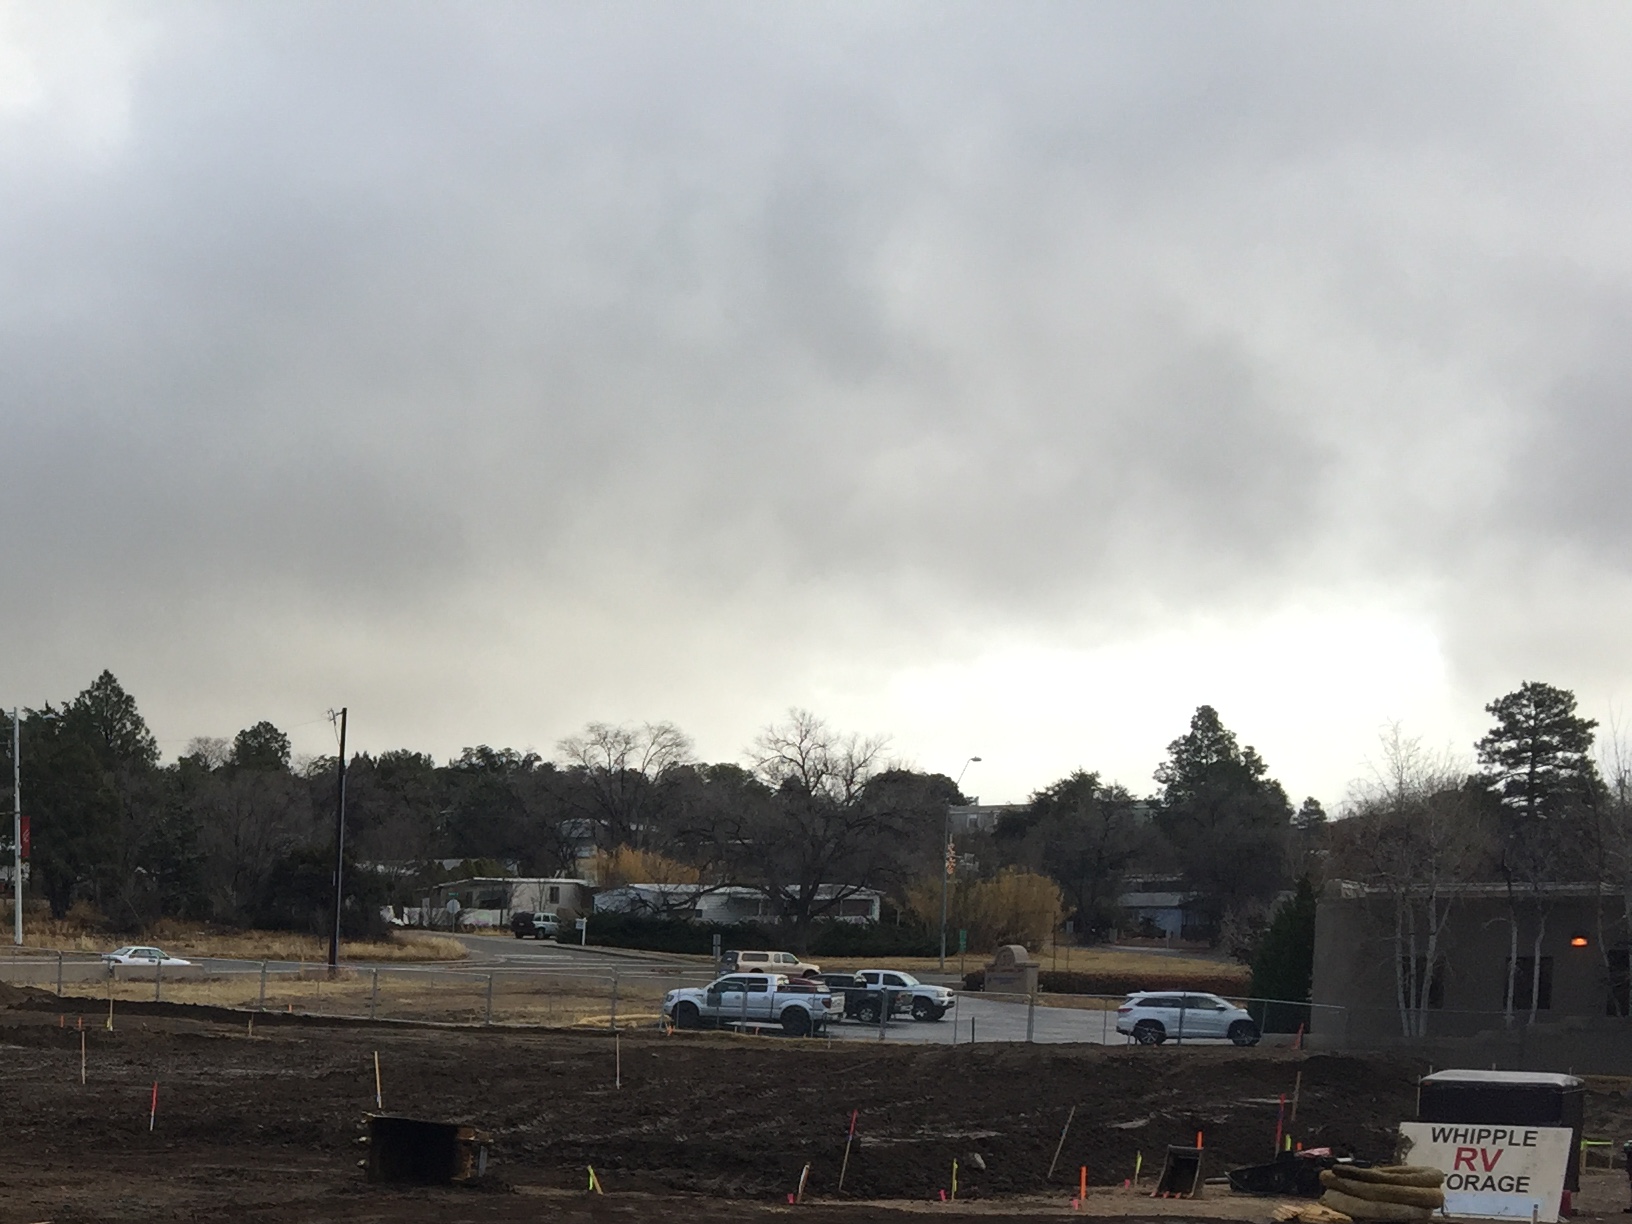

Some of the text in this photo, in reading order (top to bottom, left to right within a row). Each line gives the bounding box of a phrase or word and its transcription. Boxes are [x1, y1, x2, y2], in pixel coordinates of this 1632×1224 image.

[1432, 1127, 1538, 1147] WHIPPLE
[1454, 1147, 1504, 1172] RV
[1444, 1174, 1531, 1193] ORAGE
